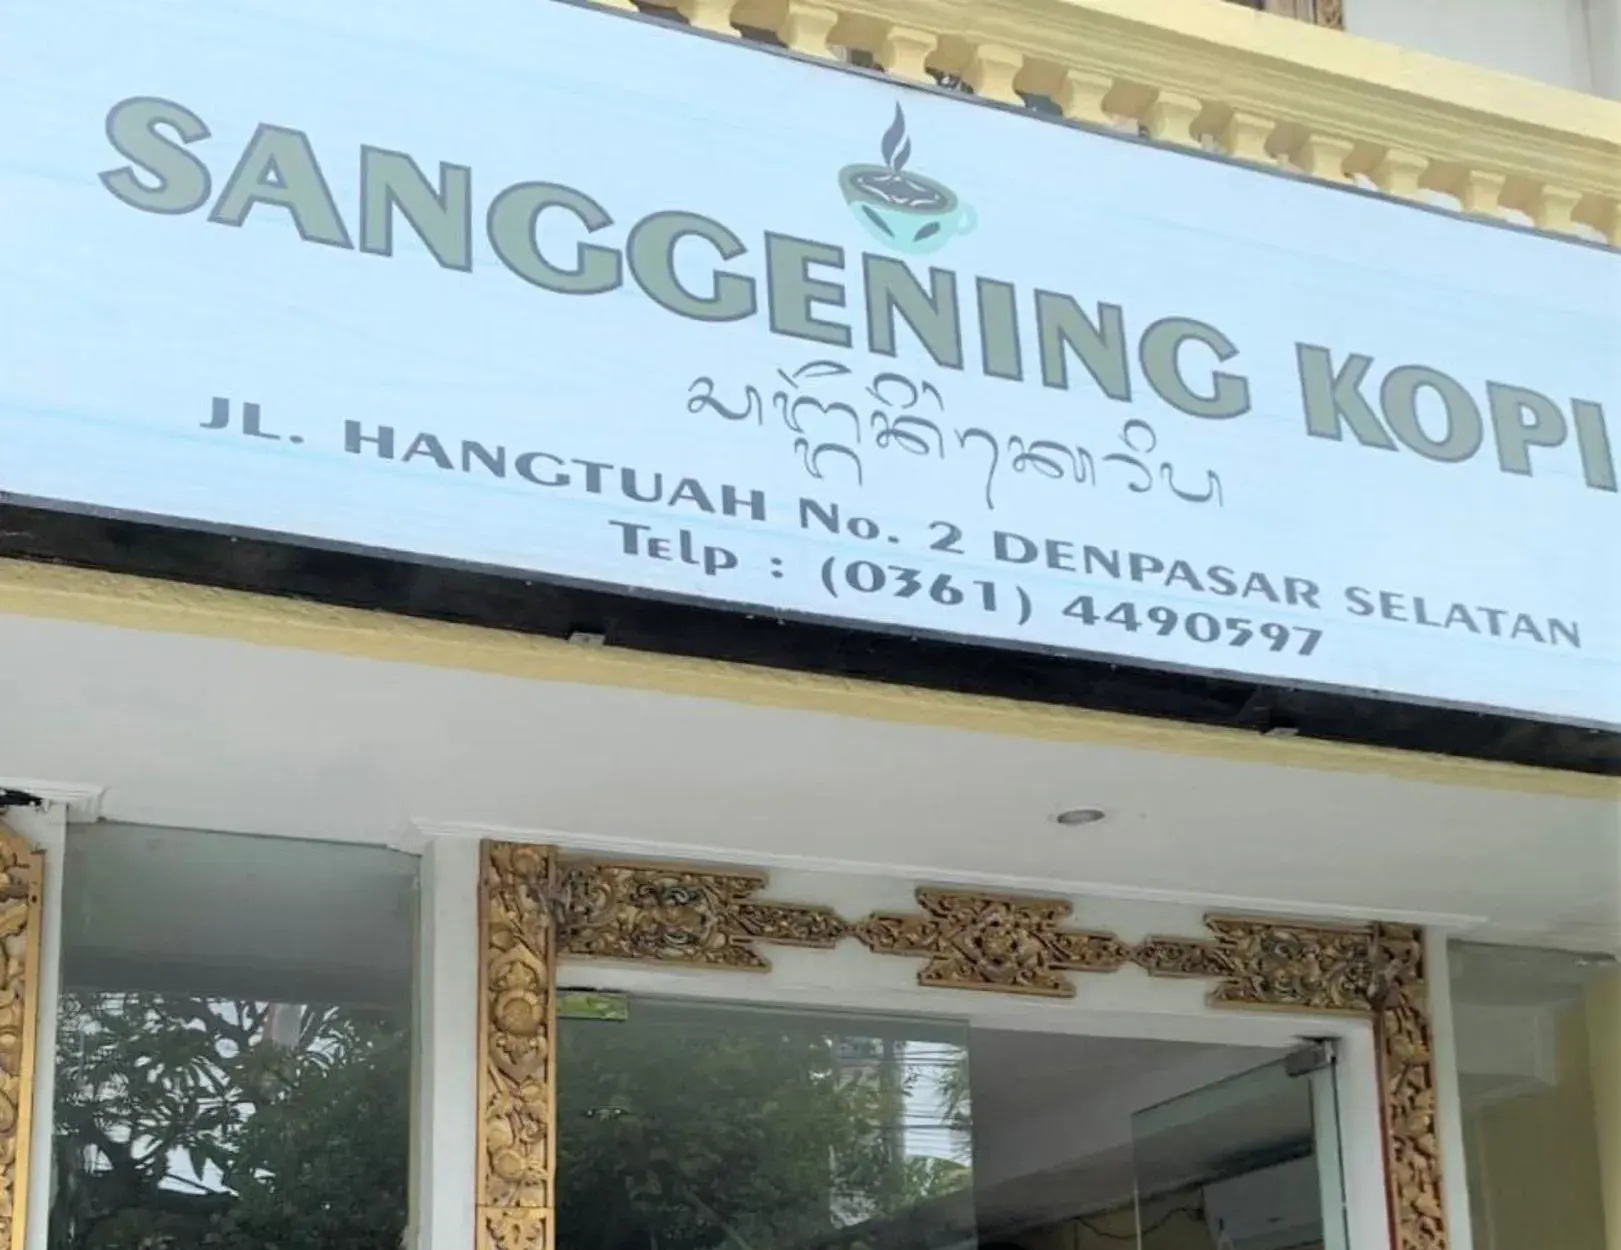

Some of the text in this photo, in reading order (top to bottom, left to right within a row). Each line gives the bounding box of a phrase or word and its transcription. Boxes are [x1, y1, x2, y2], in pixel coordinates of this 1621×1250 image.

[97, 96, 1253, 421] SANGGENING
[1294, 342, 1619, 493] KOPI
[199, 396, 305, 445] JL.
[343, 419, 767, 522] HANGTUAH
[798, 497, 900, 555] No.
[928, 520, 965, 555] 2
[992, 530, 1321, 610] DENPASAR
[1344, 586, 1581, 649] SELATAN
[607, 519, 739, 577] Telp
[820, 555, 1033, 627] (0361)
[1061, 595, 1323, 657] 4490597
